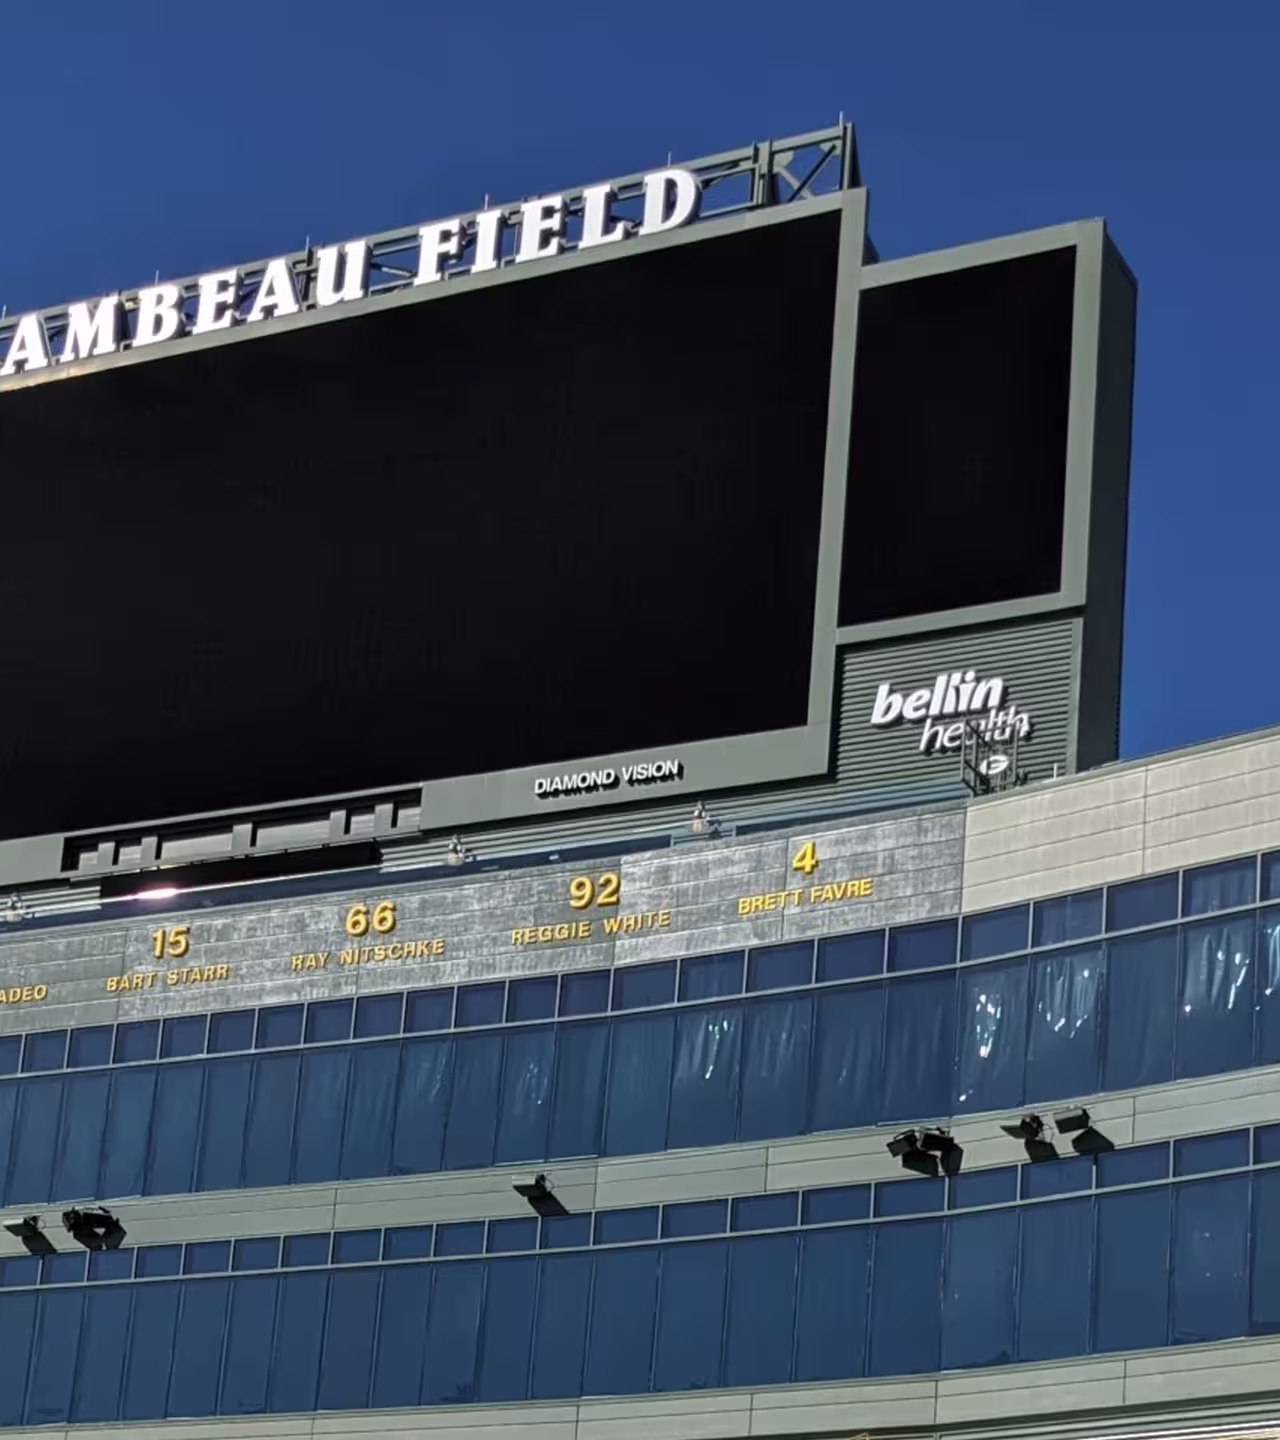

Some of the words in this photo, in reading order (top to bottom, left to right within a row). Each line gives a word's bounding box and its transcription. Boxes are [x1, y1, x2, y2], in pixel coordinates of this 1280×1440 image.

[414, 168, 702, 287] FIELD
[870, 671, 1004, 724] bellin
[534, 769, 615, 794] DIAMOND
[622, 759, 680, 781] VISION
[792, 841, 819, 876] 4
[568, 872, 621, 910] 92
[738, 890, 806, 916] BRETT
[810, 879, 874, 904] FAVRE
[345, 902, 398, 937] 66
[510, 921, 592, 946] REGGIE
[603, 910, 672, 935] WHITE
[151, 926, 190, 958] 15
[290, 953, 330, 972] RAY
[339, 939, 446, 967] NITSCHKE
[106, 972, 157, 993] BART
[166, 964, 229, 987] STARR
